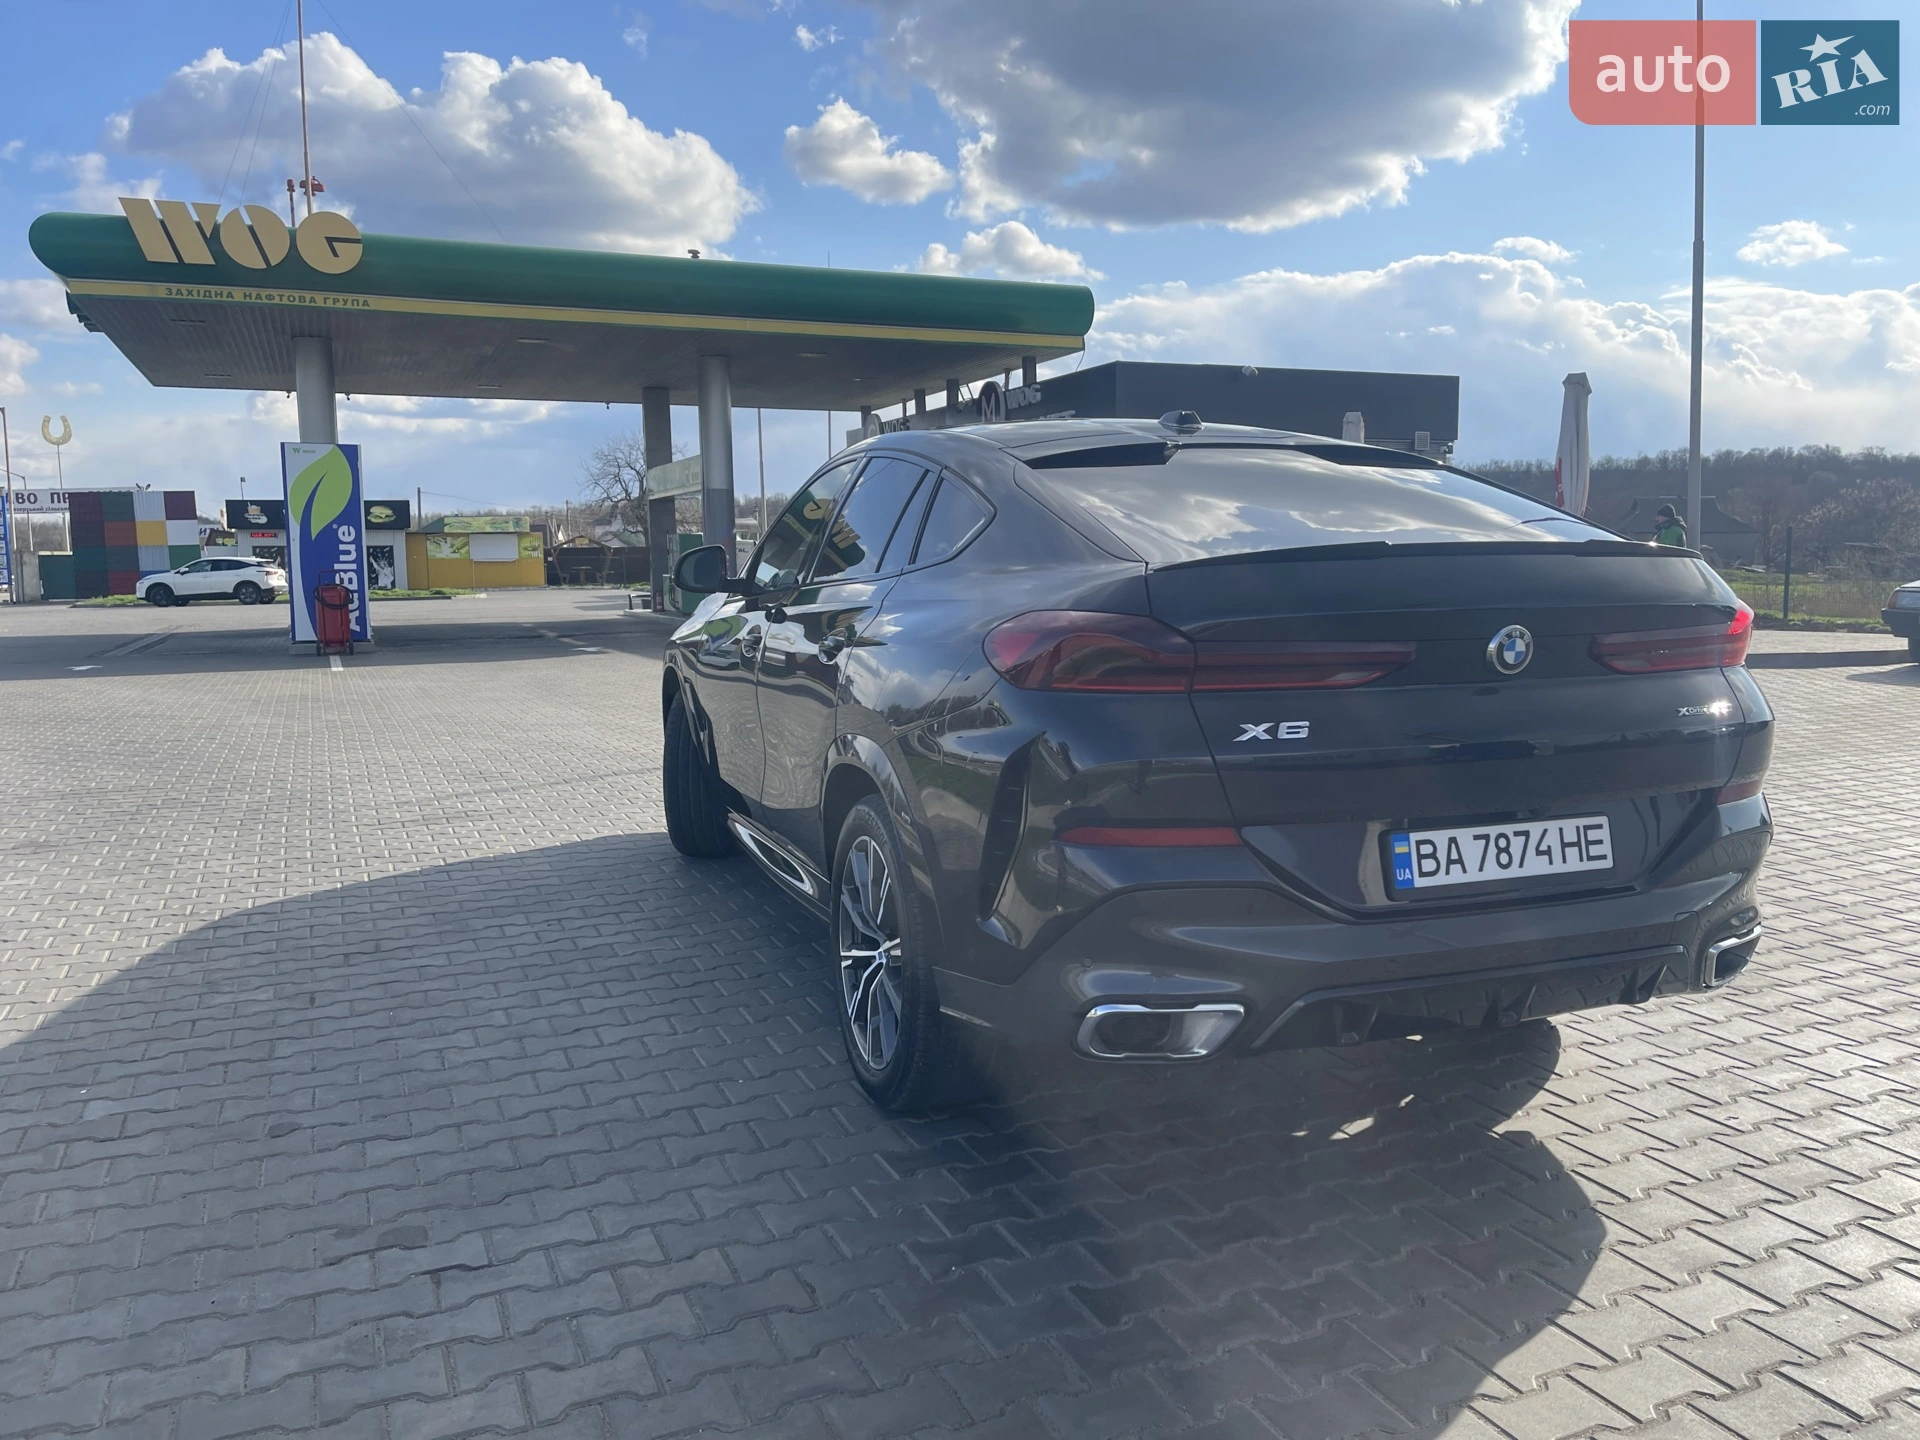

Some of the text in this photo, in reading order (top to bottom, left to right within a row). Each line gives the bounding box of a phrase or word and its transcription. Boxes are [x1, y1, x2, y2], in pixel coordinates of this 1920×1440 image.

[118, 196, 363, 274] WOG
[165, 287, 371, 308] ЗАХІДНА НАФТОВА ГРУПА
[1006, 384, 1042, 410] WOG
[1232, 721, 1310, 741] X6
[1396, 868, 1412, 881] UA
